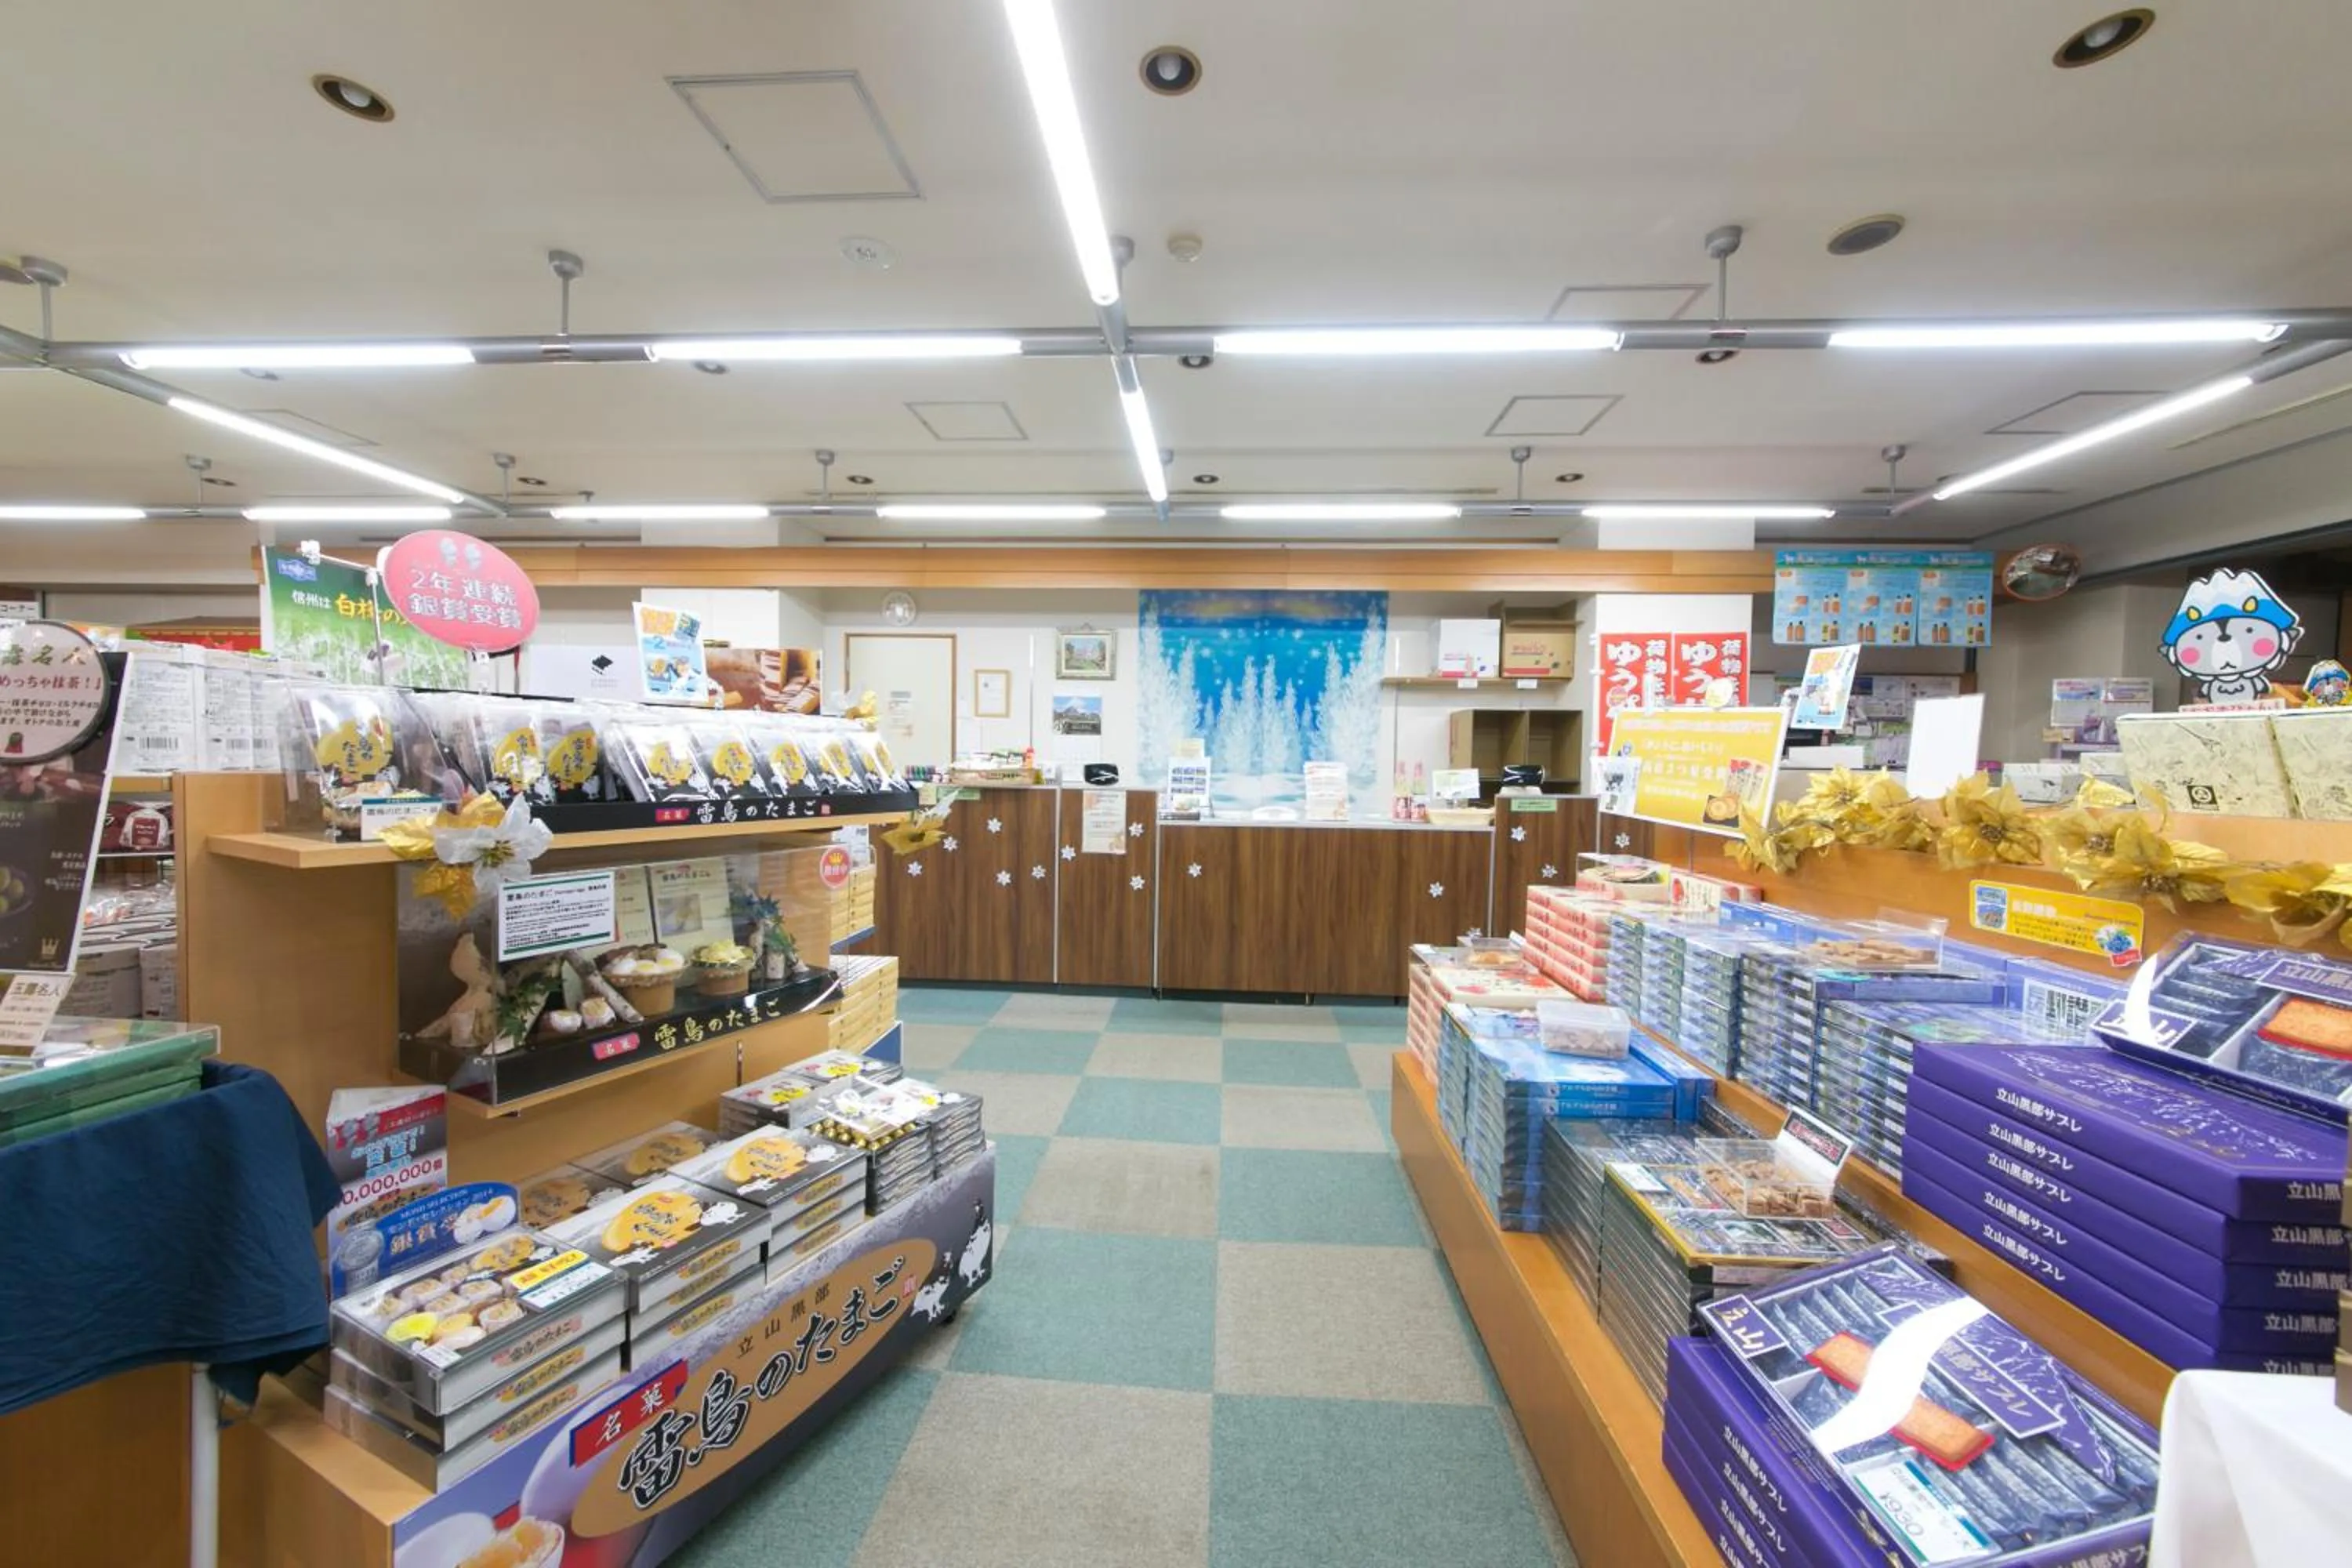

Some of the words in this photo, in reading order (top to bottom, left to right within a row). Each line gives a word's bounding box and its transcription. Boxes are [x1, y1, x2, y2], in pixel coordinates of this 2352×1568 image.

[292, 588, 332, 609] 信州は
[408, 592, 523, 629] 銀賞受賞
[412, 571, 517, 605] 2年連続
[696, 800, 816, 824] 雷鳥のたまご
[655, 997, 782, 1051] 雷鳥のたまご
[1995, 1087, 2082, 1134] 立山黒部サブレ
[1988, 1123, 2074, 1171] 立山黒部サブレ
[1987, 1152, 2071, 1203] 立山黒部サブレ
[1984, 1191, 2068, 1247] 立山黒部サブレ
[1983, 1223, 2066, 1281] 立山黒部サブレ
[735, 1282, 831, 1359] 立山黒部
[617, 1254, 906, 1509] 雷鳥のたまご
[595, 1383, 664, 1446] 名菓
[1724, 1425, 1788, 1513] 立山黒部サブレ
